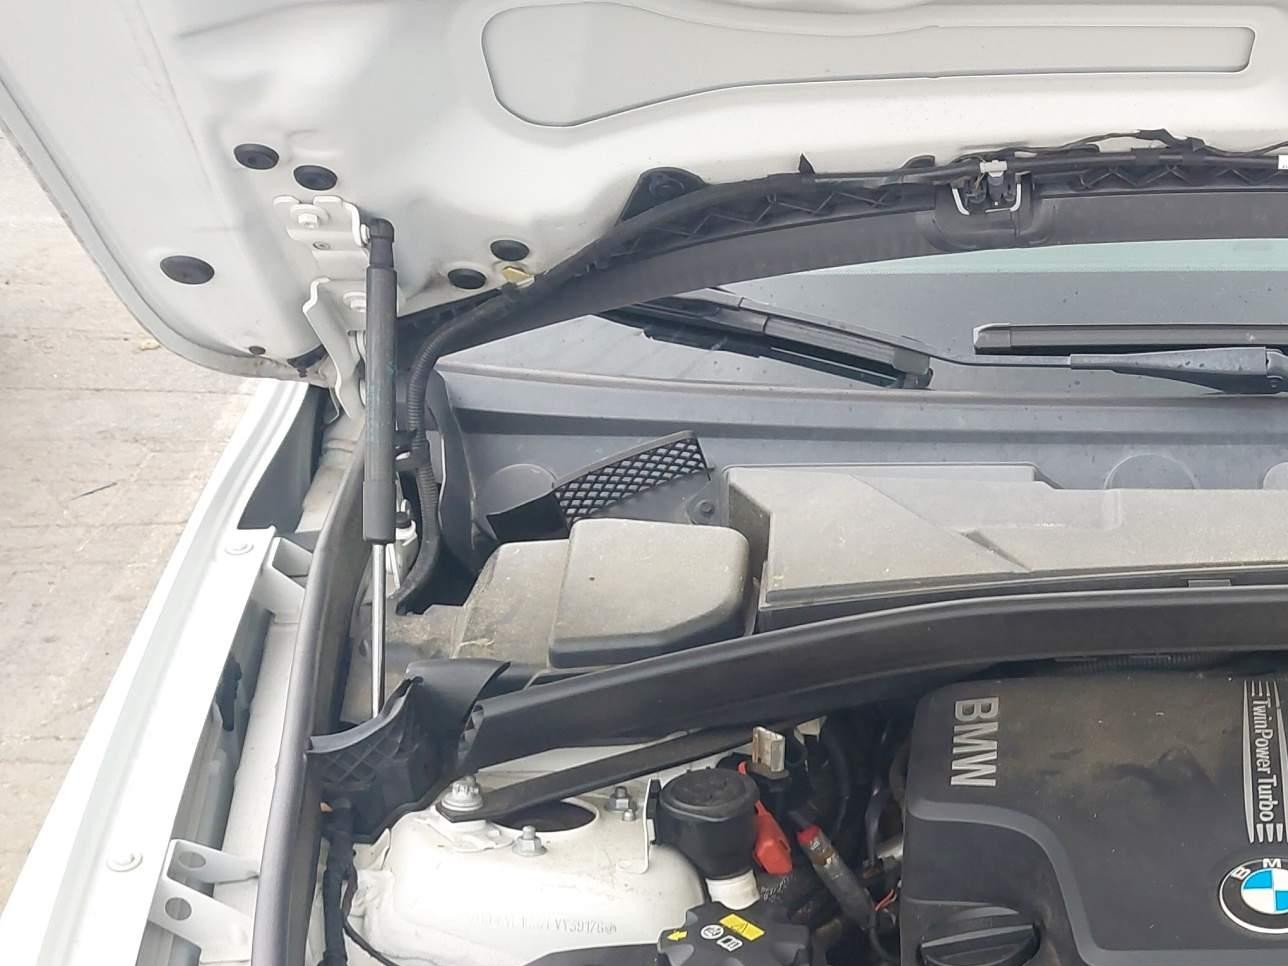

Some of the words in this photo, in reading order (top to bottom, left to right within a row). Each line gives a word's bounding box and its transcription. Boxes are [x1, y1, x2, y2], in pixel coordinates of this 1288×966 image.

[950, 696, 1000, 787] BMW
[1252, 699, 1274, 774] TwinPower
[1257, 774, 1279, 822] Turbo
